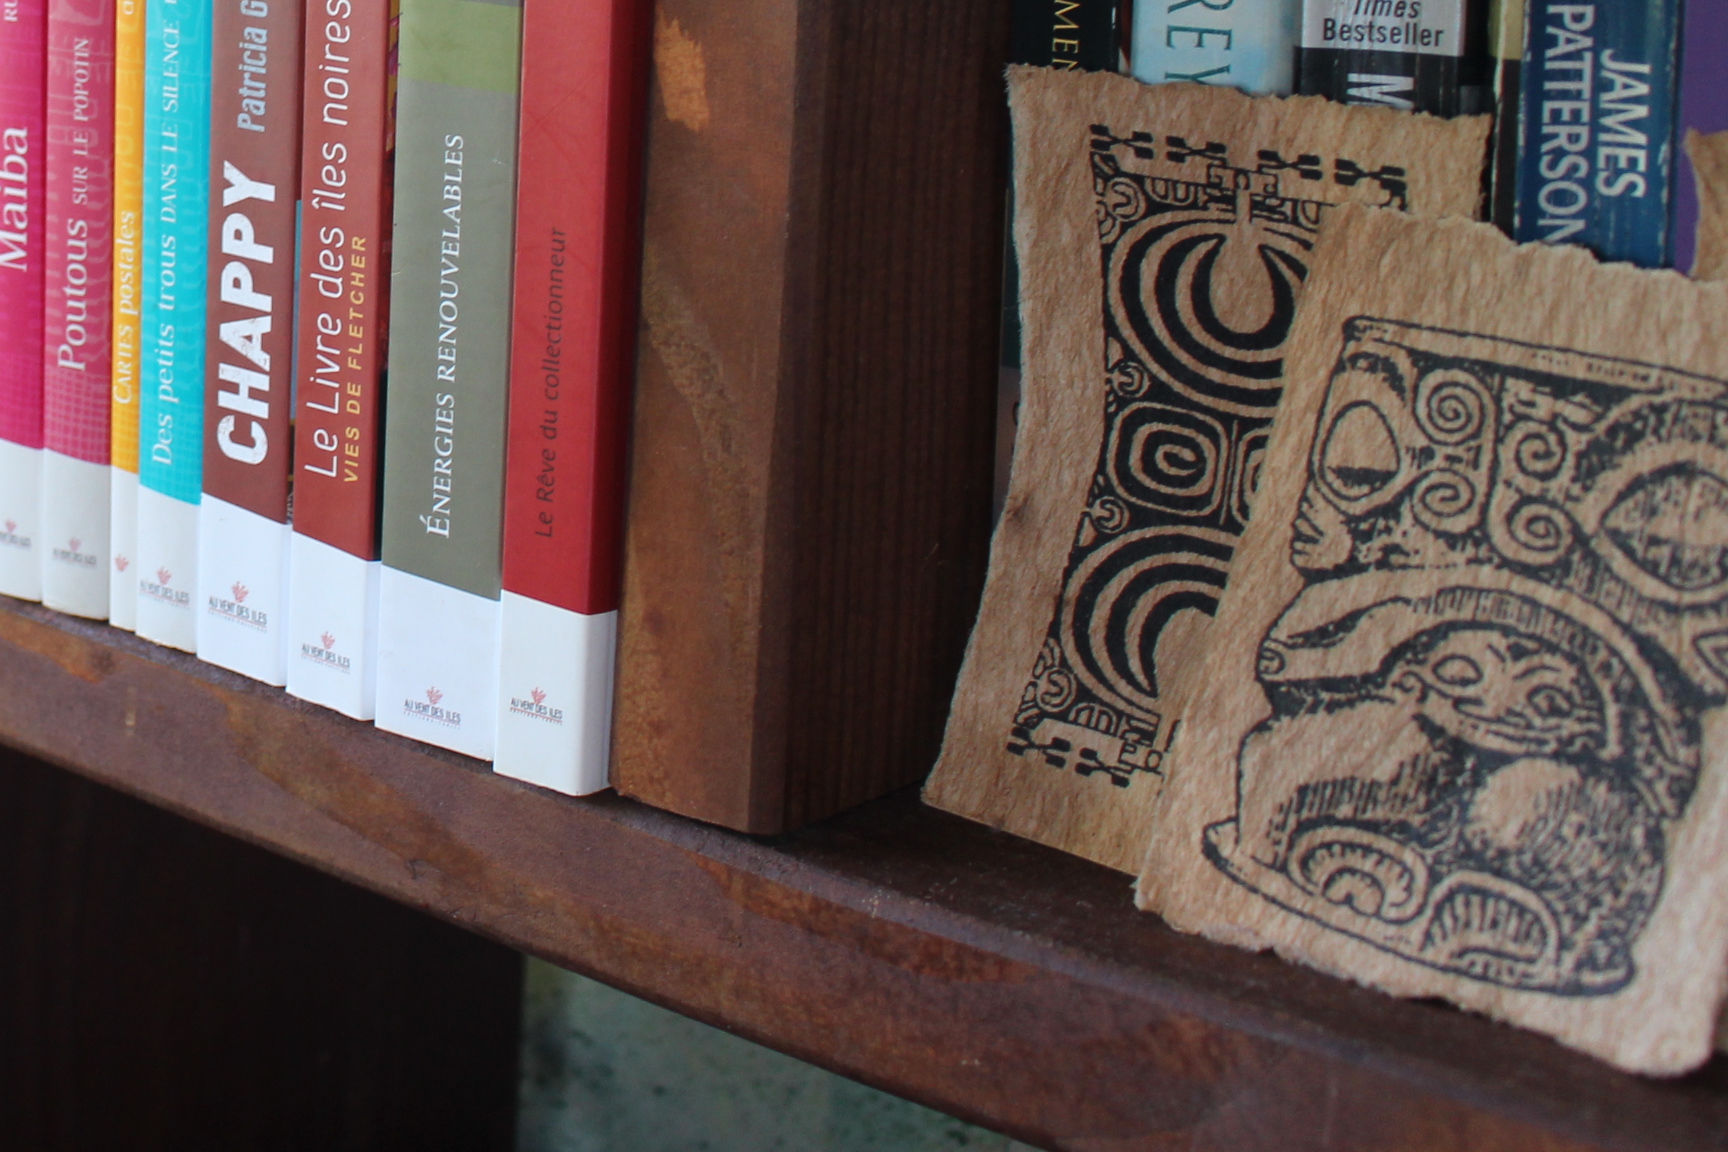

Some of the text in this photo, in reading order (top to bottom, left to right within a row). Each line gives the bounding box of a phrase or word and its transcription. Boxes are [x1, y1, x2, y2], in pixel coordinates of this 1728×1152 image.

[237, 26, 269, 133] Patricia
[1323, 18, 1444, 48] Bestseller
[1536, 4, 1596, 244] PATTERSON
[1594, 48, 1652, 198] JAMES
[57, 37, 90, 371] Poutous SUR LE POPOTIN
[312, 141, 348, 211] îles
[115, 211, 139, 315] postales
[152, 20, 180, 466] Des petits trous DANS LE SILENCE
[310, 226, 345, 299] des
[216, 159, 277, 466] CHAPPY
[305, 312, 343, 415] Livre
[343, 235, 367, 483] VIES DE FLETCHER
[419, 133, 465, 539] ÉNERGIES RENOUVELABLES
[535, 226, 567, 539] Le Rêve du collectionneur
[304, 428, 339, 478] Le
[219, 599, 236, 614] VENT
[236, 605, 250, 619] DES
[251, 610, 268, 625] ILES
[338, 654, 351, 668] ILES
[414, 701, 431, 715] VENT
[431, 705, 445, 719] DES
[446, 710, 462, 725] ILES
[549, 707, 563, 720] ILES
